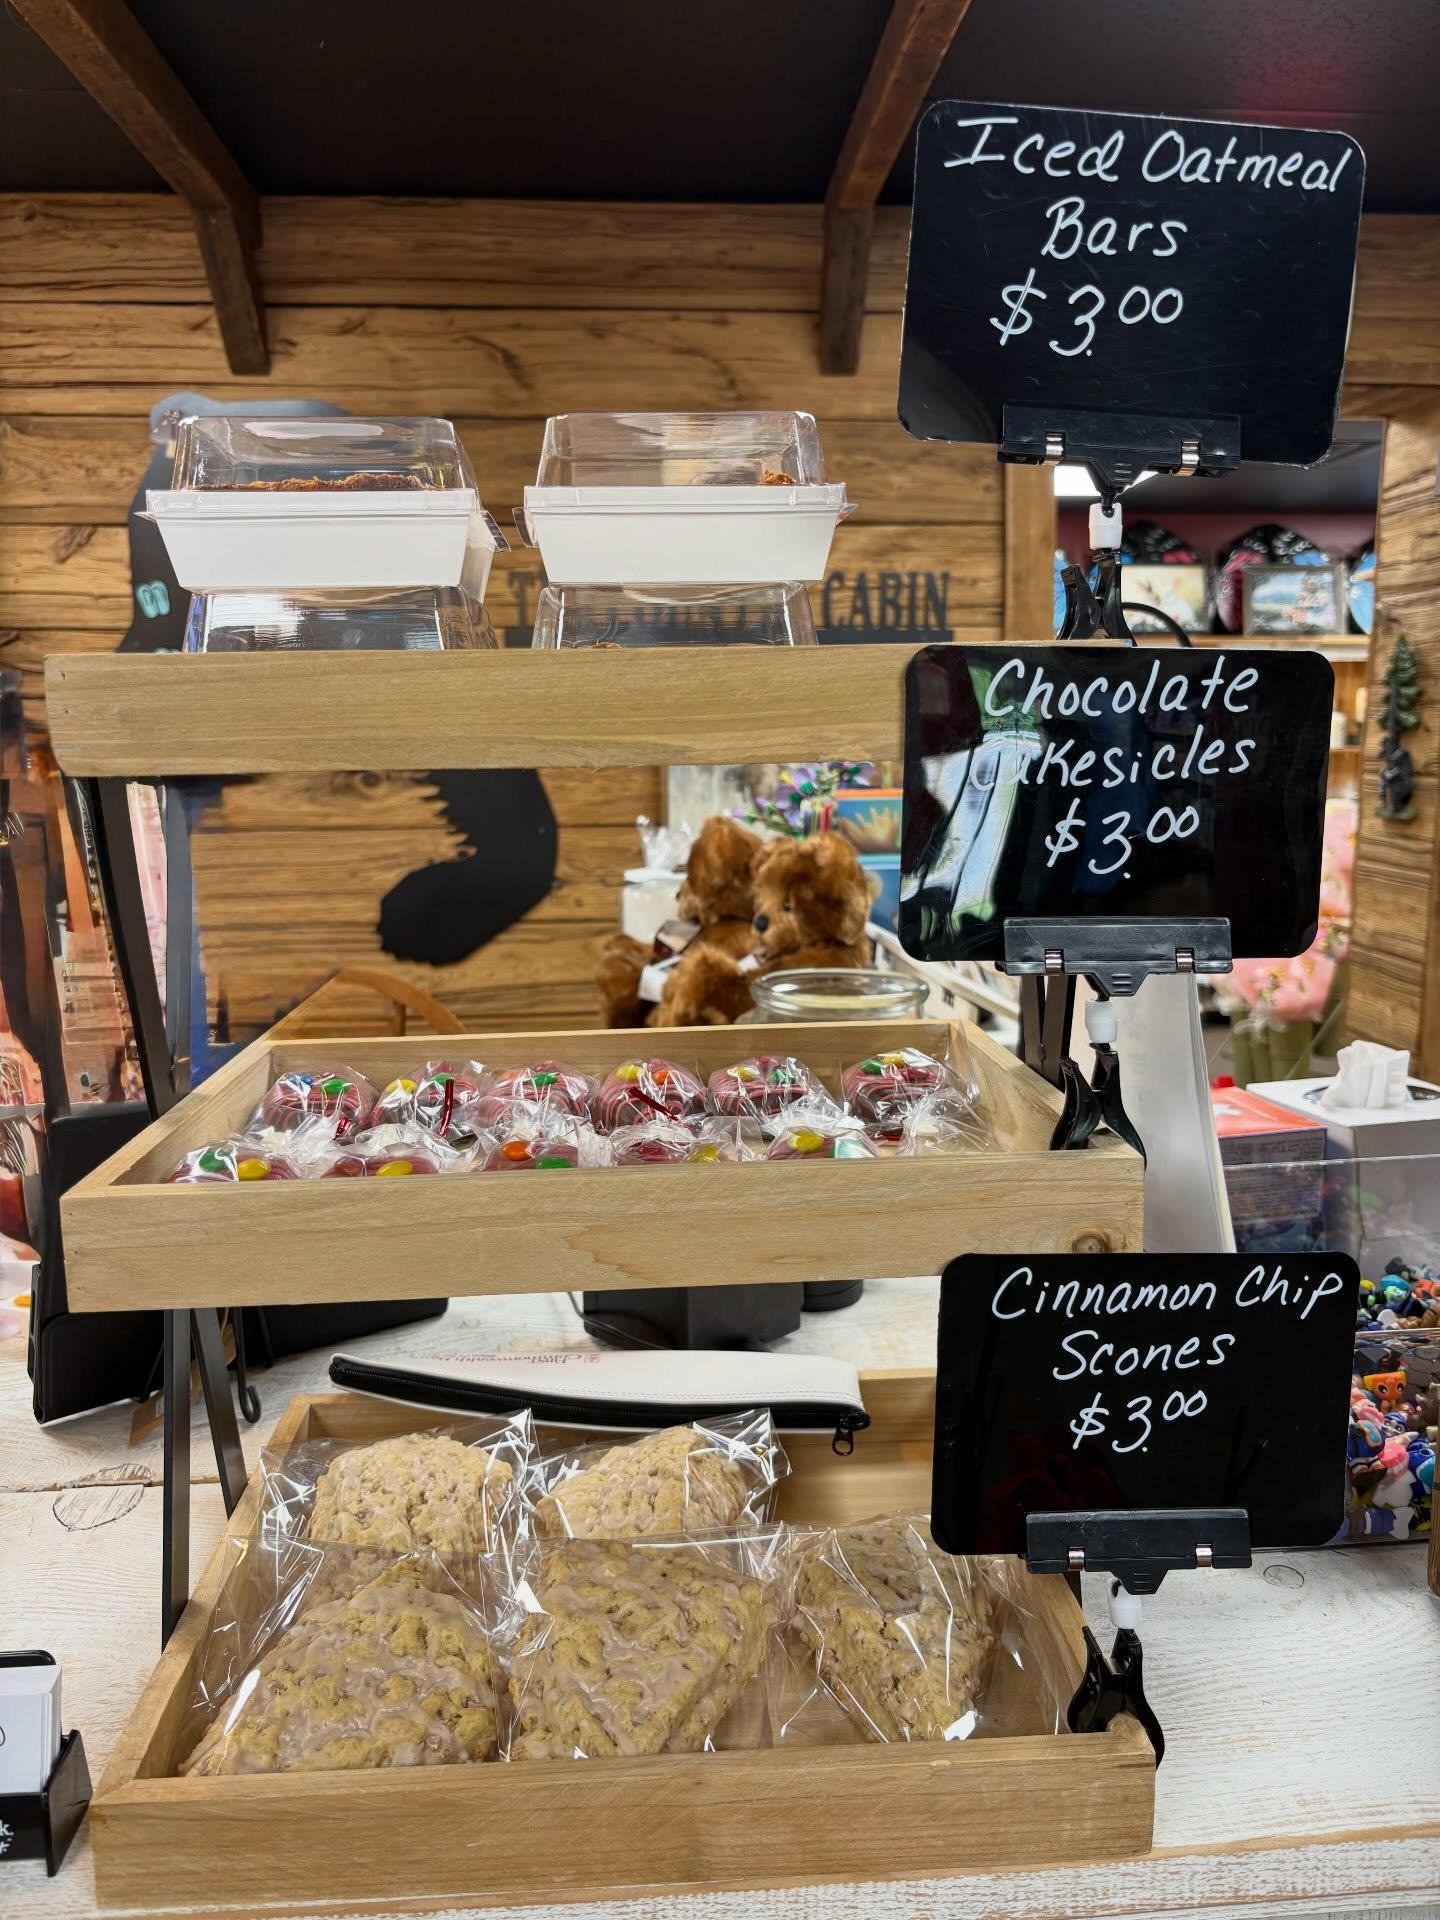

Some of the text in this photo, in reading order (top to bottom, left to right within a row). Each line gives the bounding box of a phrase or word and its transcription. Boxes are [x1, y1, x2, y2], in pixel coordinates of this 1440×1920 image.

[944, 117, 1353, 193] Iced Oatmeal
[1041, 196, 1188, 260] Bars
[823, 571, 951, 630] CABIN
[984, 655, 1259, 720] Chocolate
[991, 1265, 1343, 1320] Cinnamon Chip
[1052, 1329, 1236, 1381] Scones
